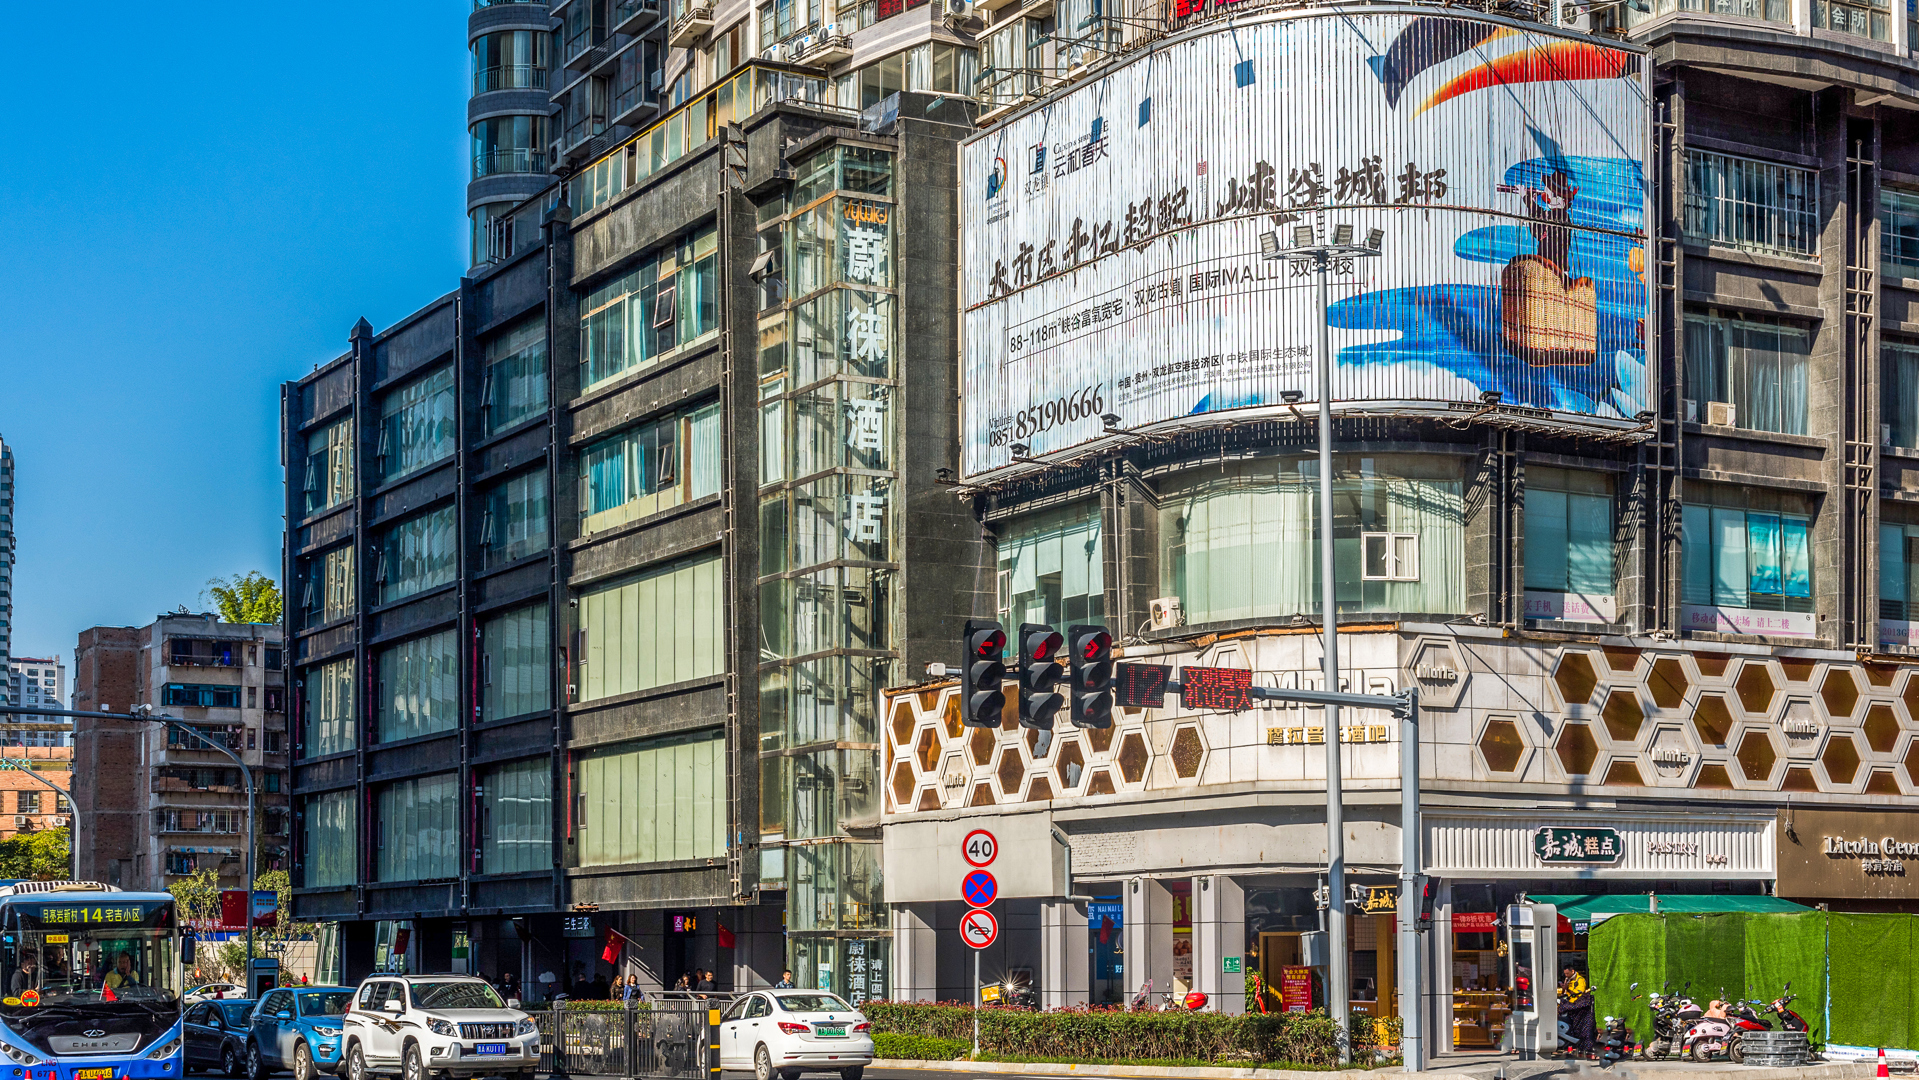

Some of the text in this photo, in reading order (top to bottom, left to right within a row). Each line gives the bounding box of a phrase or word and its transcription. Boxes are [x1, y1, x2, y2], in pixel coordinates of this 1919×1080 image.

[1053, 136, 1109, 180] 云和春天
[1024, 171, 1049, 197] 双龙镇
[1524, 599, 1590, 615] 买手机 送话费
[1757, 617, 1790, 630] 请上二楼
[1128, 666, 1163, 705] 12
[1184, 667, 1252, 688] 文明驾驶
[1184, 686, 1253, 709] 礼让行人
[1266, 725, 1388, 745] 穆拉音酒吧
[968, 840, 992, 857] 40
[1540, 828, 1616, 859] 嘉诚糕点
[1646, 841, 1698, 856] PASTRY
[1823, 836, 1879, 854] Licoln
[1366, 888, 1397, 911] 嘉诚
[43, 908, 140, 923] 月亮岩新村 14 宅吉小区
[41, 1059, 57, 1067] LNG
